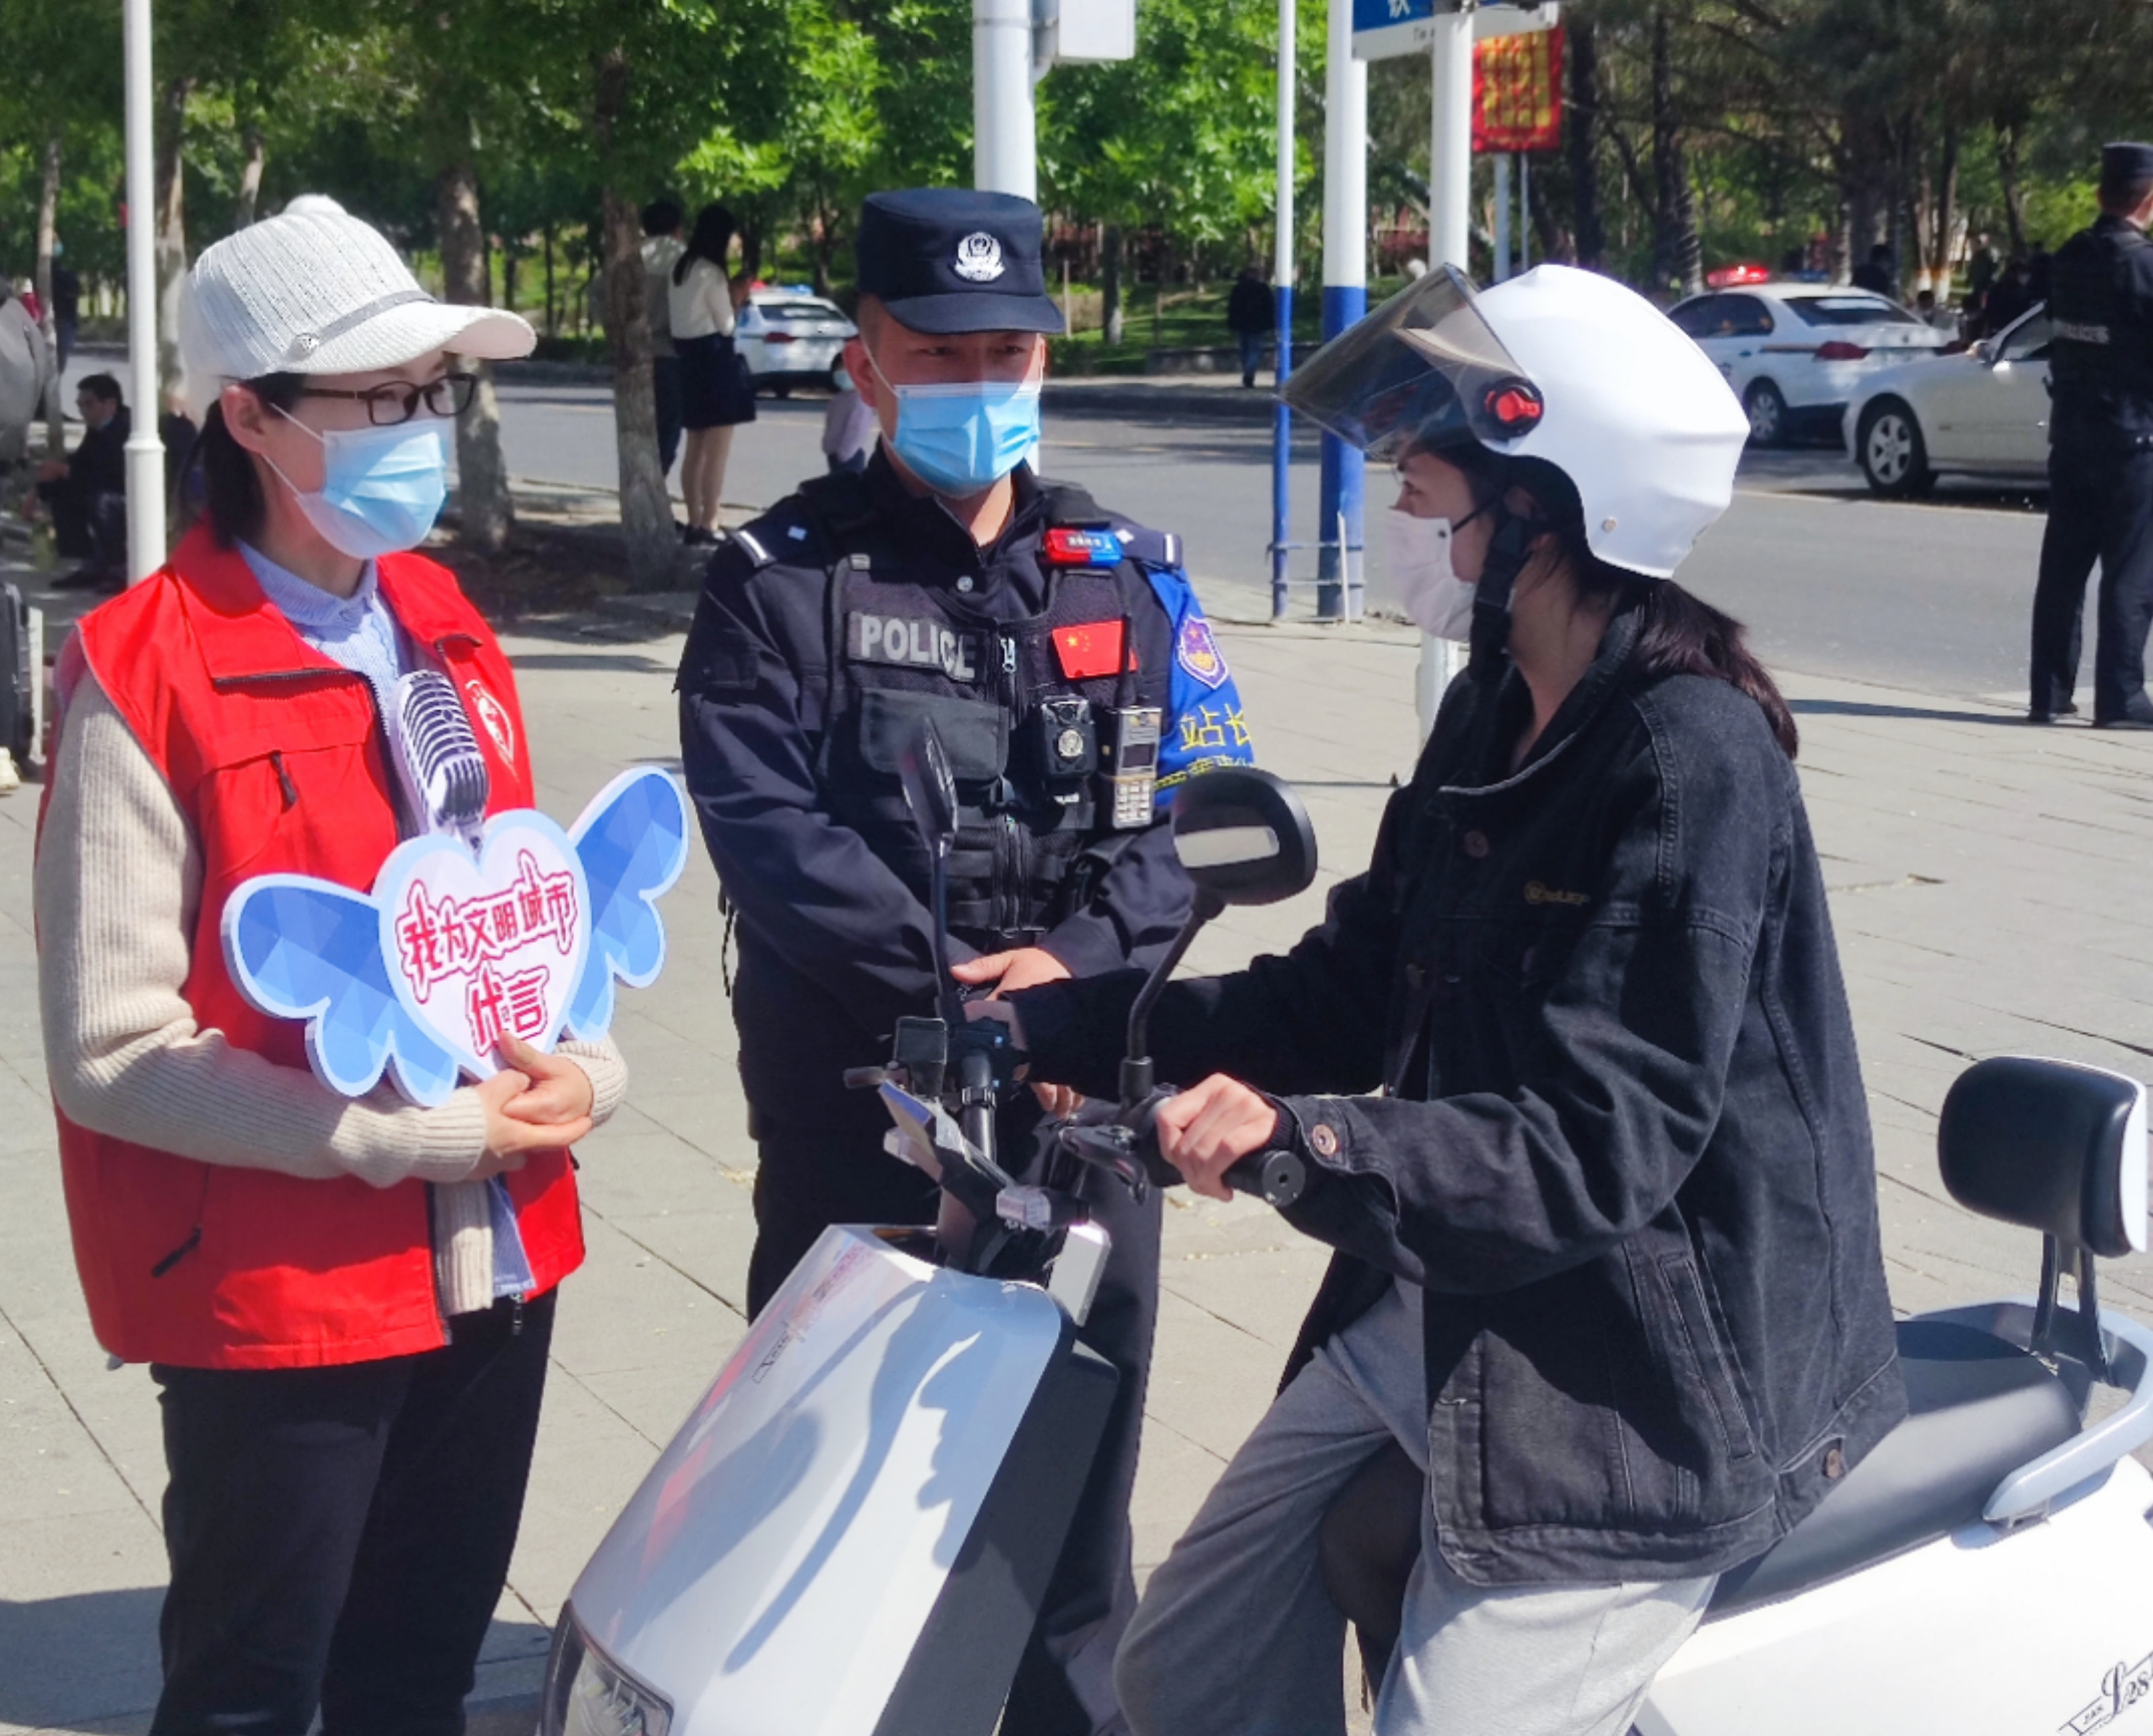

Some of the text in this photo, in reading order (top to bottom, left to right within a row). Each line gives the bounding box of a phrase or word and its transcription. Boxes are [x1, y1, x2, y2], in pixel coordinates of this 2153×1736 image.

[860, 614, 976, 679] POLICE
[400, 854, 575, 993] 我为文明城市
[470, 966, 546, 1048] 代言
